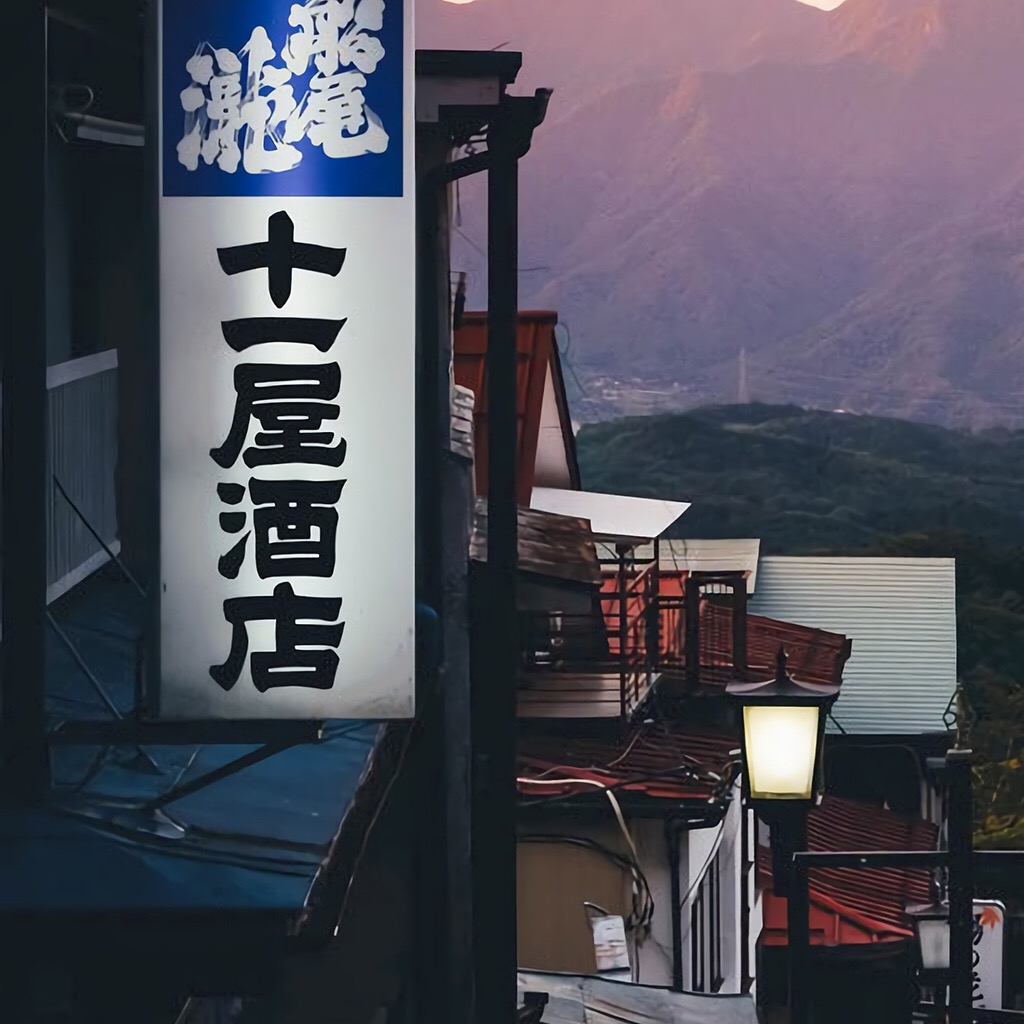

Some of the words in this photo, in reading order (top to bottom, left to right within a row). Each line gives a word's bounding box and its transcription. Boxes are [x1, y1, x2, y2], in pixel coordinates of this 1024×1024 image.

[209, 210, 347, 692] 十一屋酒店
